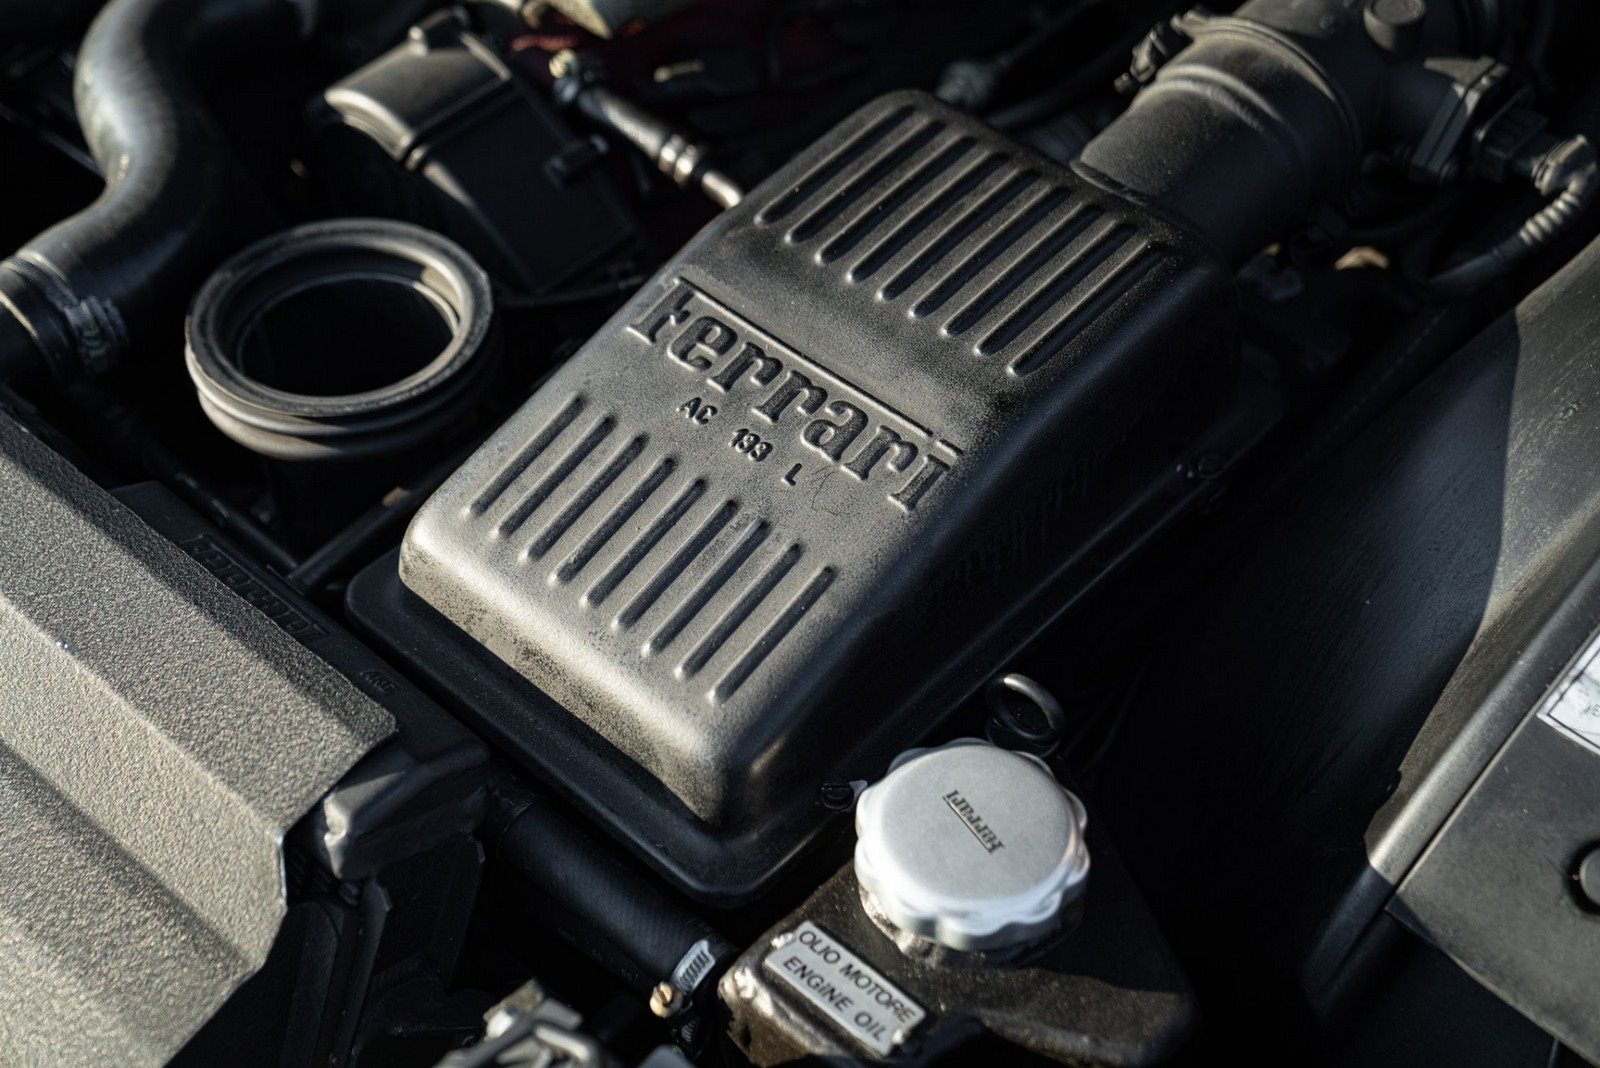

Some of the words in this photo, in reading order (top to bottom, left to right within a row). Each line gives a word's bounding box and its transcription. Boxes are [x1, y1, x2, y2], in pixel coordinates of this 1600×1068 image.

[625, 276, 962, 513] Ferrari
[675, 397, 718, 425] AC
[728, 428, 773, 462] 133
[781, 463, 803, 487] L
[942, 790, 1005, 853] Ferrari
[783, 956, 854, 1013] ENGINE
[854, 1010, 886, 1042] OIL
[799, 930, 841, 965] OLIO
[839, 962, 918, 1024] MOTORE
